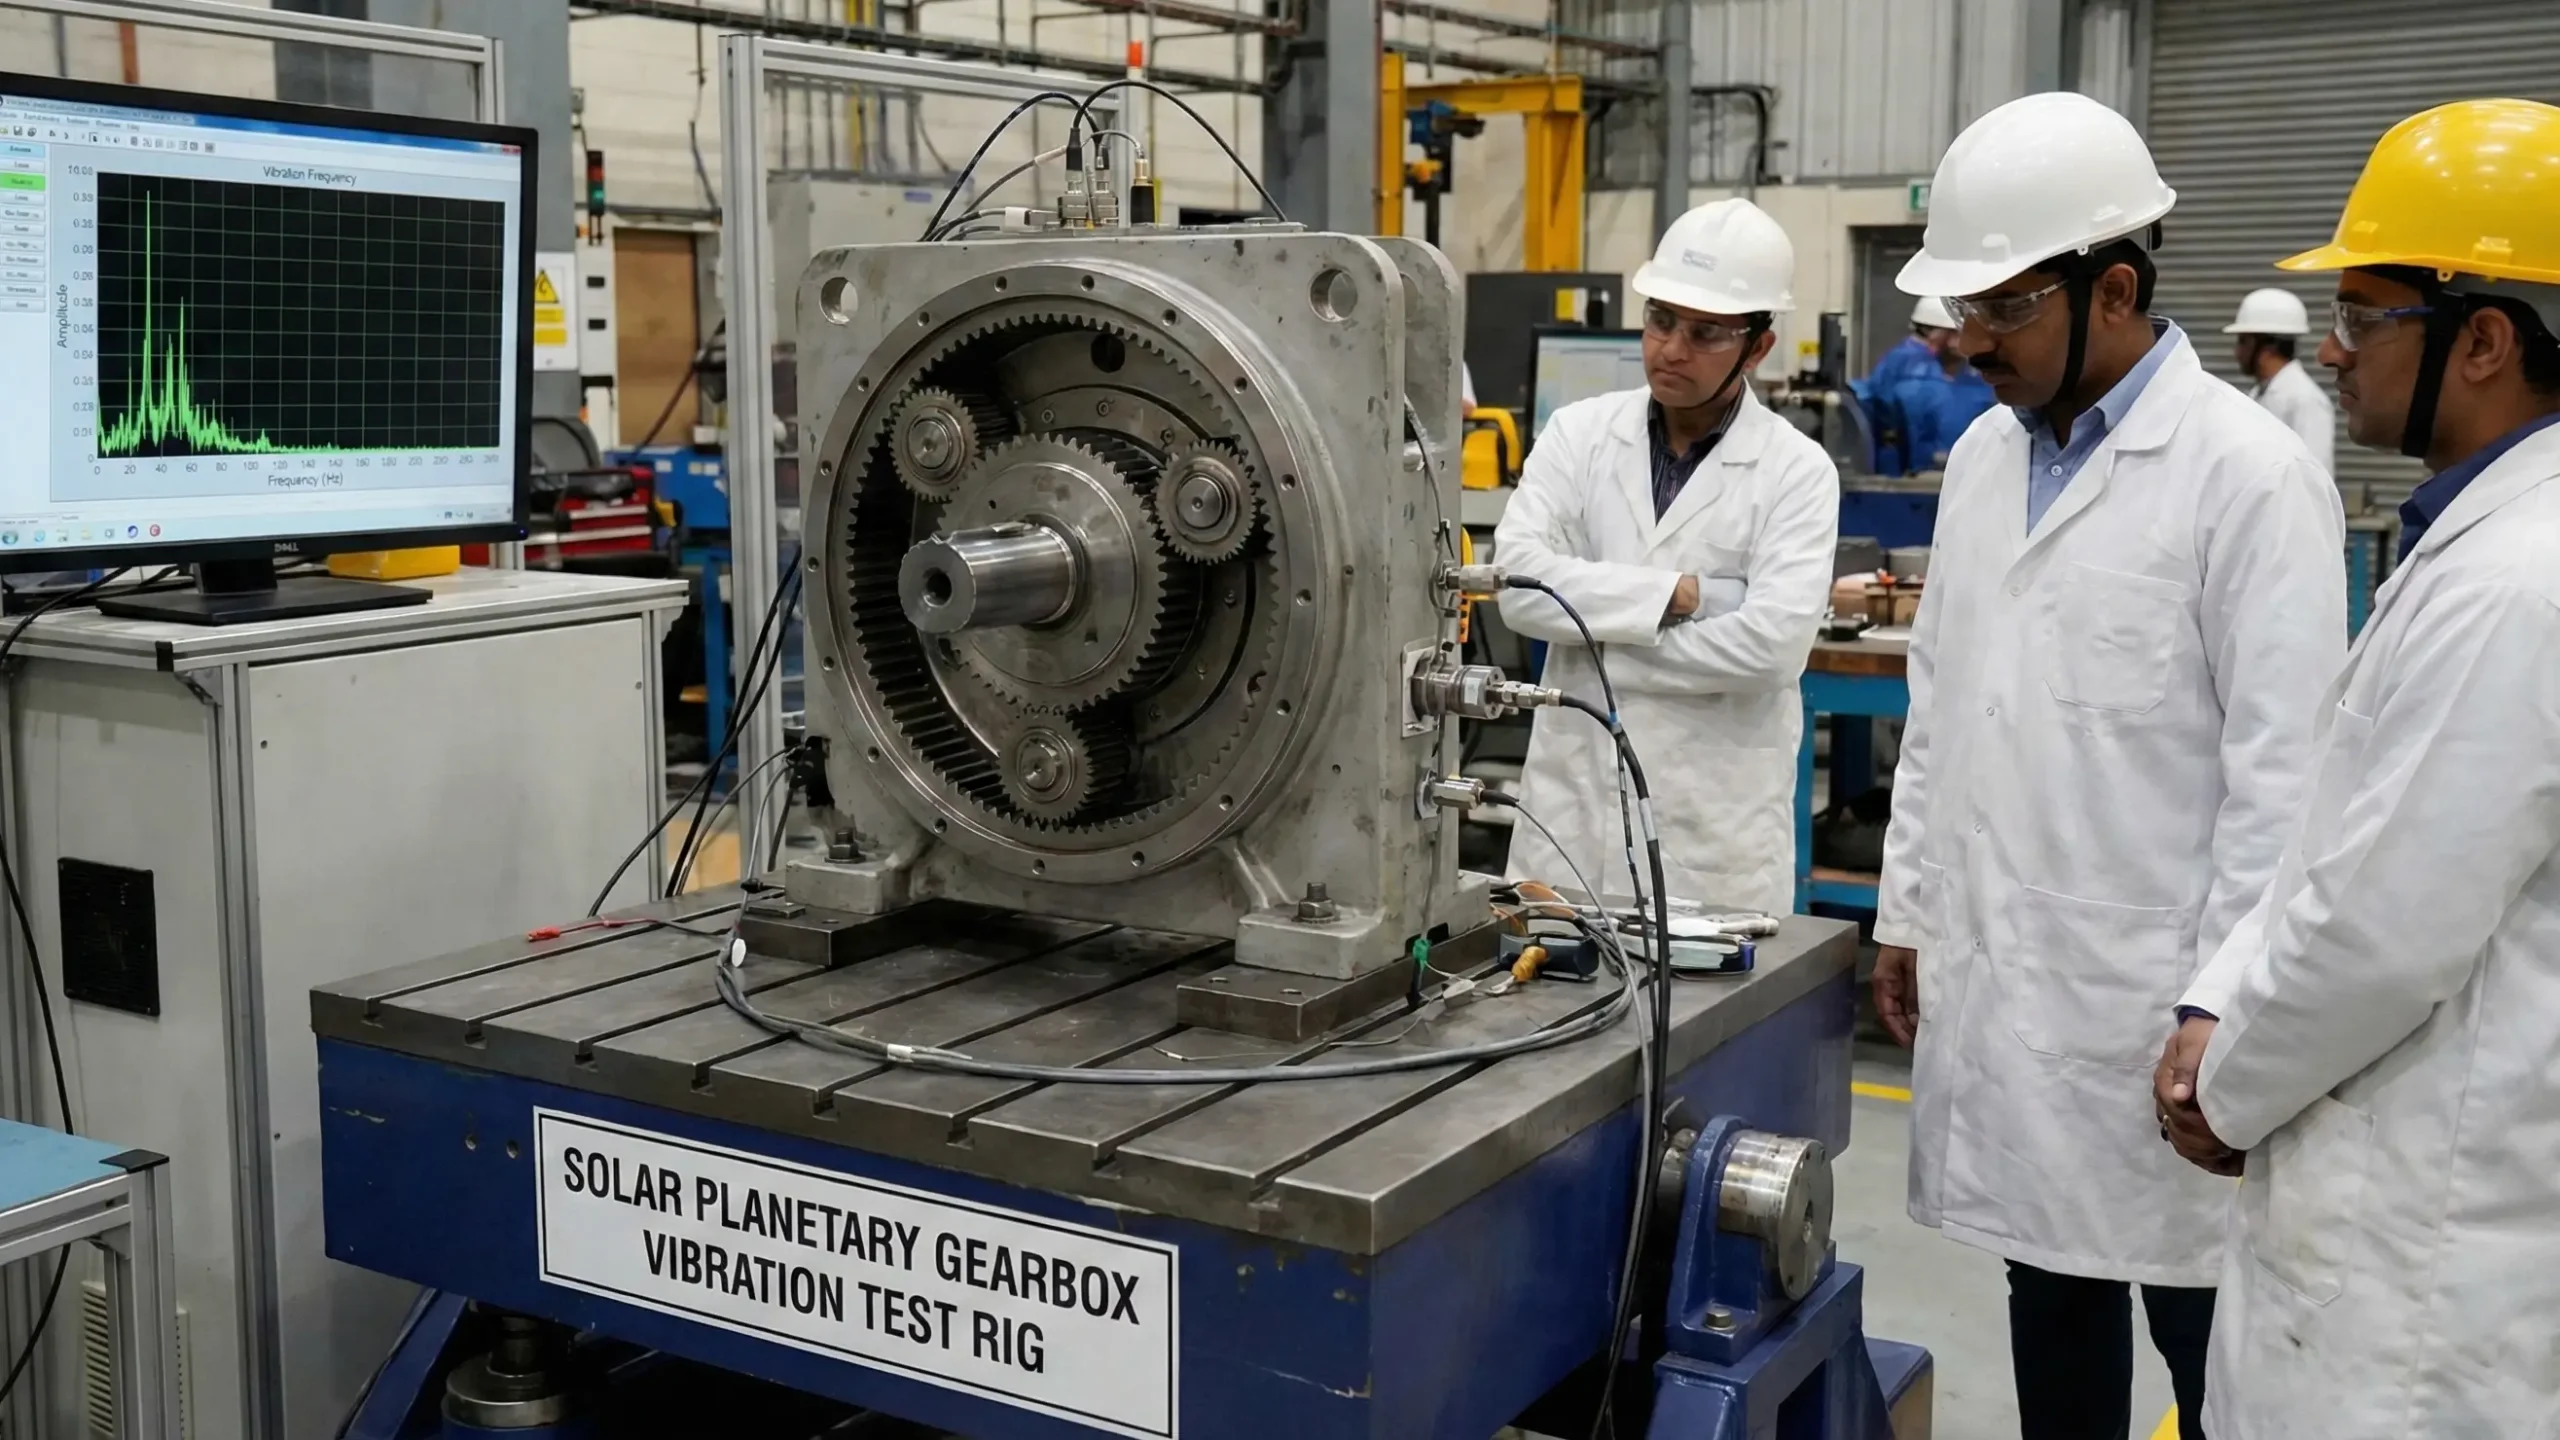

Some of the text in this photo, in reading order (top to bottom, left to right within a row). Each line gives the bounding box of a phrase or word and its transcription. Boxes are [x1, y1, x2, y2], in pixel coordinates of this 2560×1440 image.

[94, 465, 101, 475] 0
[124, 465, 136, 475] 20
[156, 464, 167, 473] 40
[186, 463, 198, 472] 60
[268, 472, 343, 489] Frequency (Hz)
[564, 1147, 1140, 1325] SOLAR PLANETARY GEARBOX
[643, 1229, 1045, 1374] VIBRATION TEST RIG
